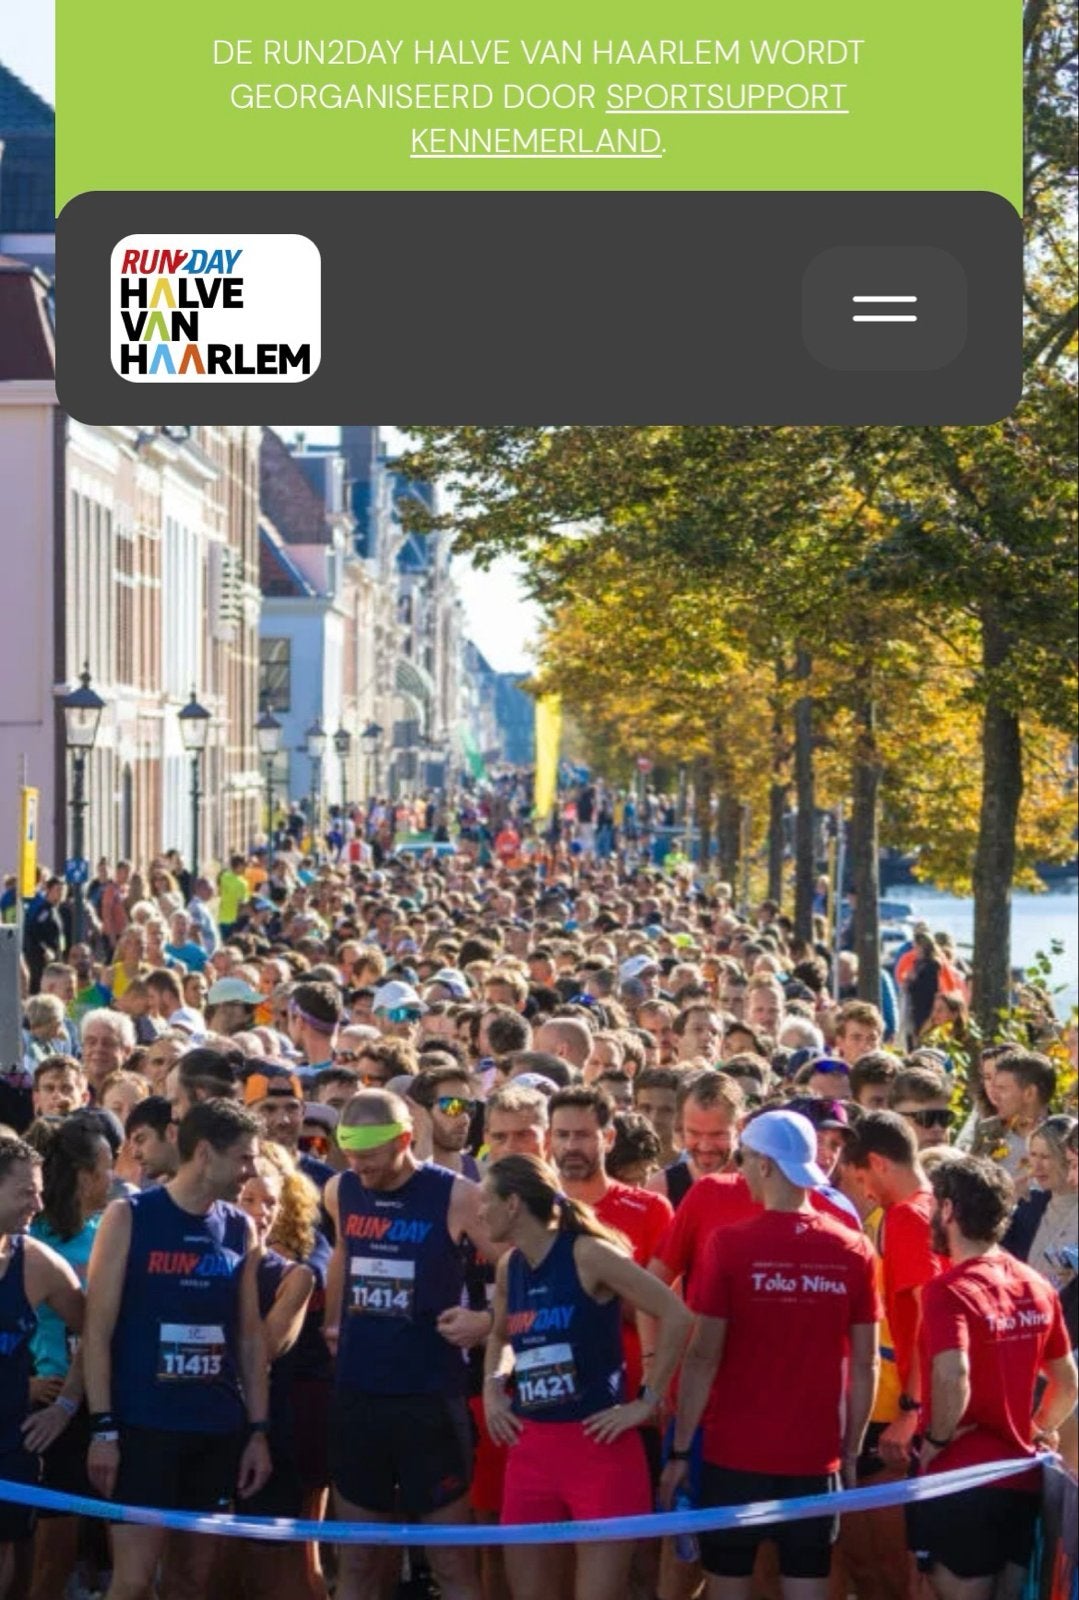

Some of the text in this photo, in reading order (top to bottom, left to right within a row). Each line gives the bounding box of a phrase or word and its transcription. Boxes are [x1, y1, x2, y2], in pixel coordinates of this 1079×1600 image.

[751, 1272, 848, 1295] Toko Nina
[352, 1286, 409, 1309] 11414
[163, 1354, 222, 1375] 11413
[518, 1373, 576, 1402] 11421
